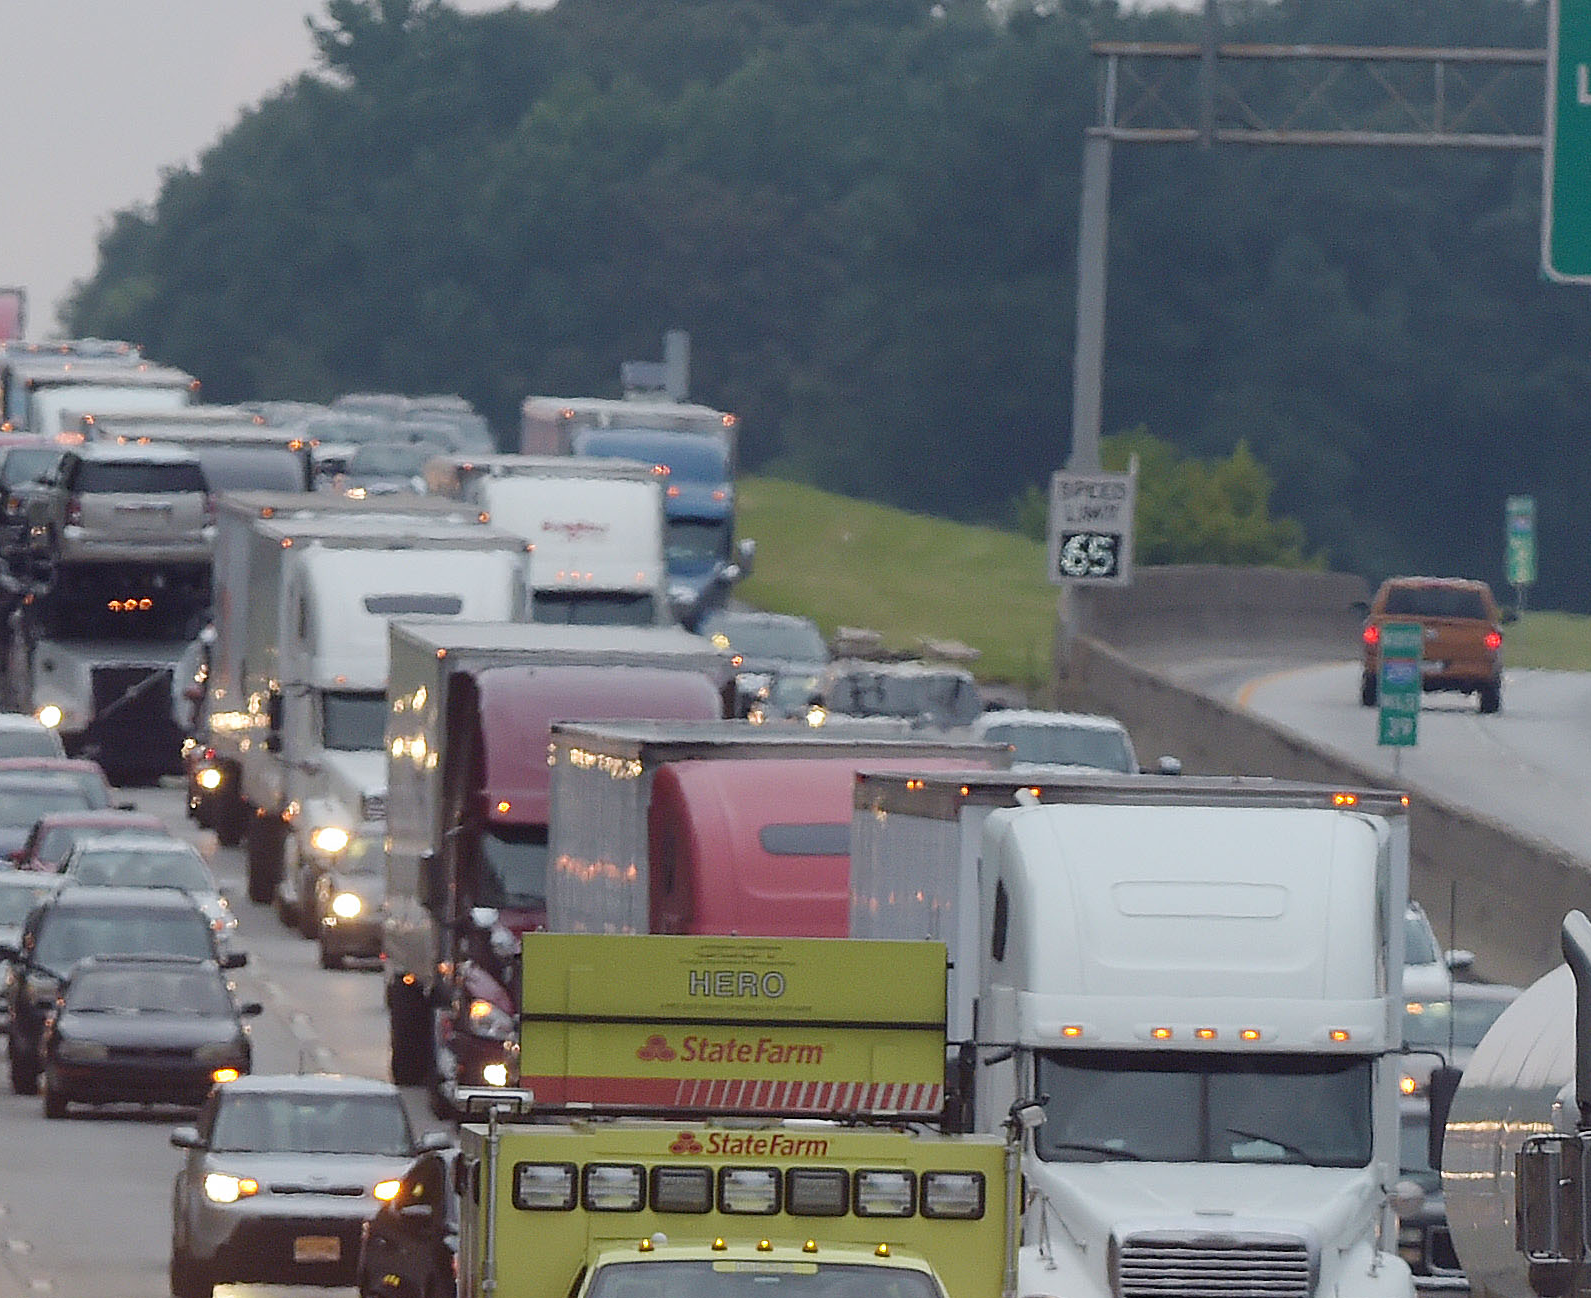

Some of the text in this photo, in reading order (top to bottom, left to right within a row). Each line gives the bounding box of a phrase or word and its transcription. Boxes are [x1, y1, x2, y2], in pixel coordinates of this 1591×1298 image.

[1060, 480, 1127, 500] SPEED
[1061, 534, 1115, 577] 65
[688, 970, 786, 998] HERO
